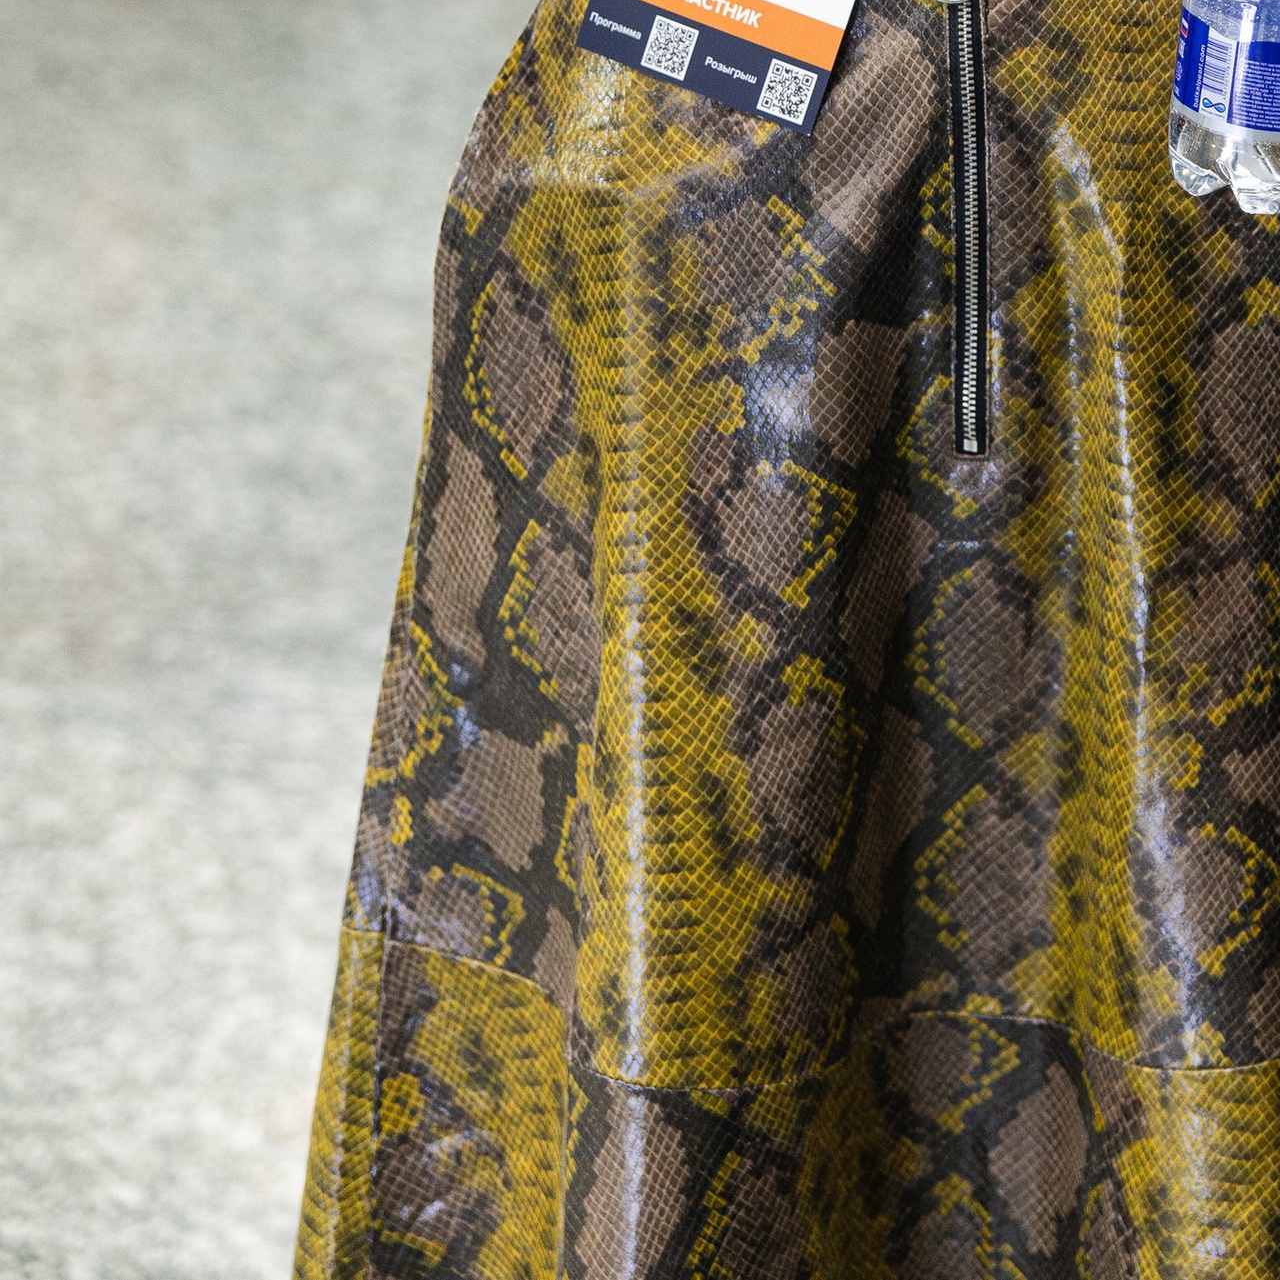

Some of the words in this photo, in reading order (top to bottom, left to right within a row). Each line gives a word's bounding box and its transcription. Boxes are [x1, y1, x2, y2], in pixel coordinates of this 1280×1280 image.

[589, 11, 642, 40] Программа
[704, 56, 758, 84] Розыгрыш
[1193, 44, 1206, 108] baikalpearl.com
